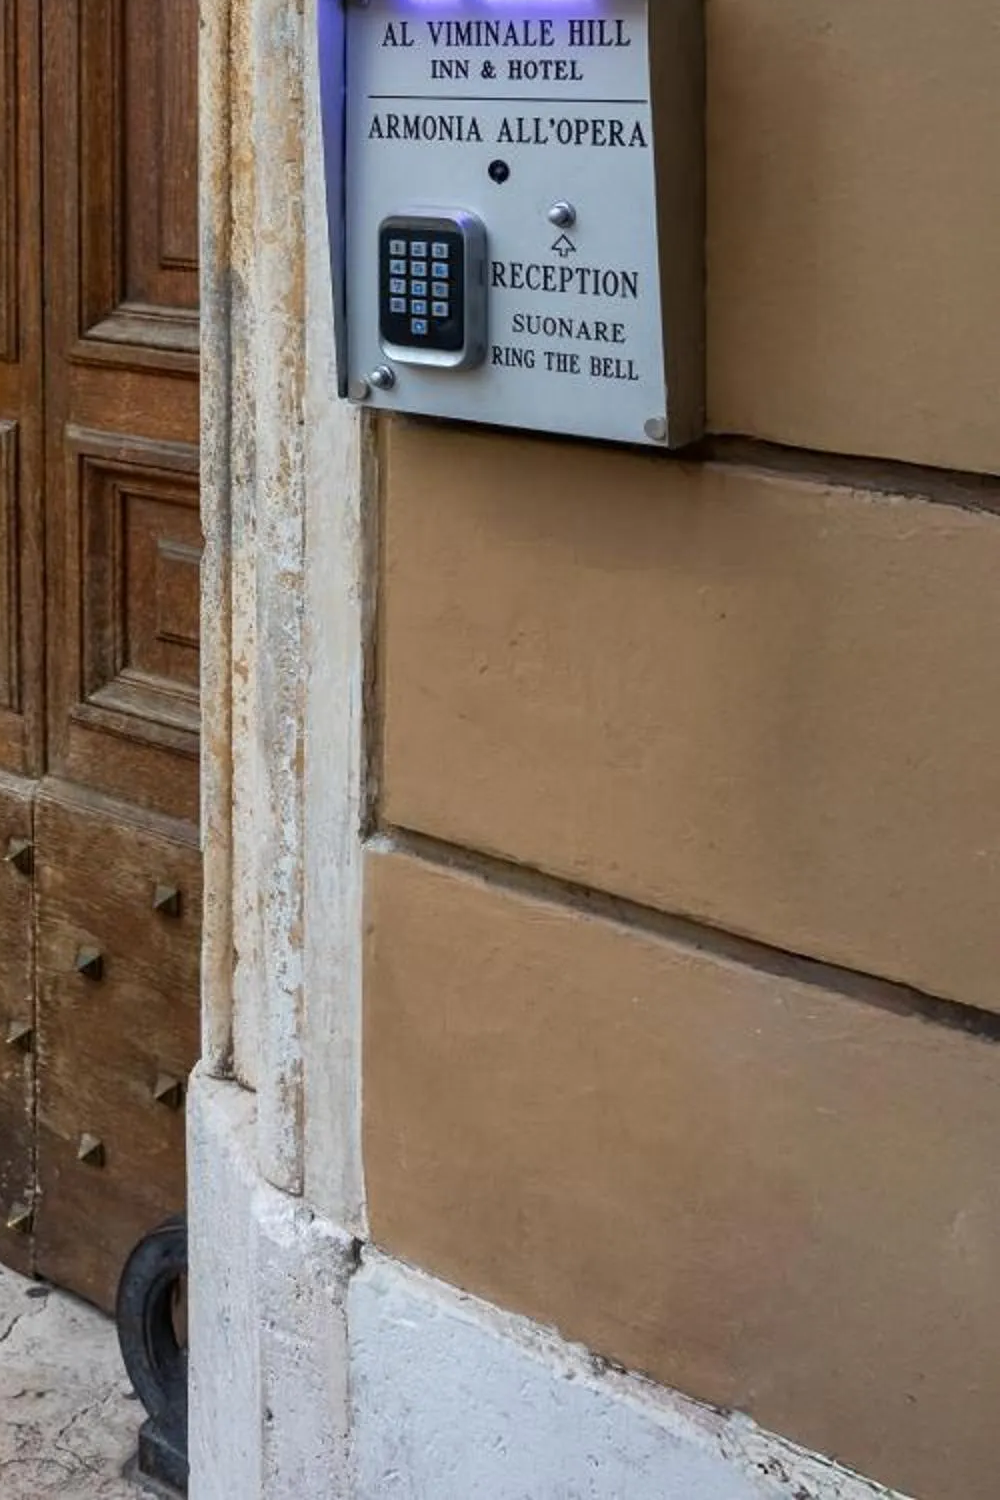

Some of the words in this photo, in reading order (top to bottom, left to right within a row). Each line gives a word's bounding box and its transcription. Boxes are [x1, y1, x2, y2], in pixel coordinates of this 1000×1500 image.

[382, 21, 415, 47] AL
[426, 19, 555, 47] VIMINALE
[568, 20, 631, 47] HILL
[430, 60, 470, 79] INN
[480, 60, 496, 79] &
[508, 59, 584, 81] HOTEL
[368, 114, 484, 142] ARMONIA
[496, 117, 647, 148] ALL'OPERA
[491, 262, 639, 300] RECEPTION
[512, 314, 626, 344] SUONARE
[491, 346, 536, 370] RING
[544, 351, 581, 375] THE
[590, 356, 639, 381] BELL
